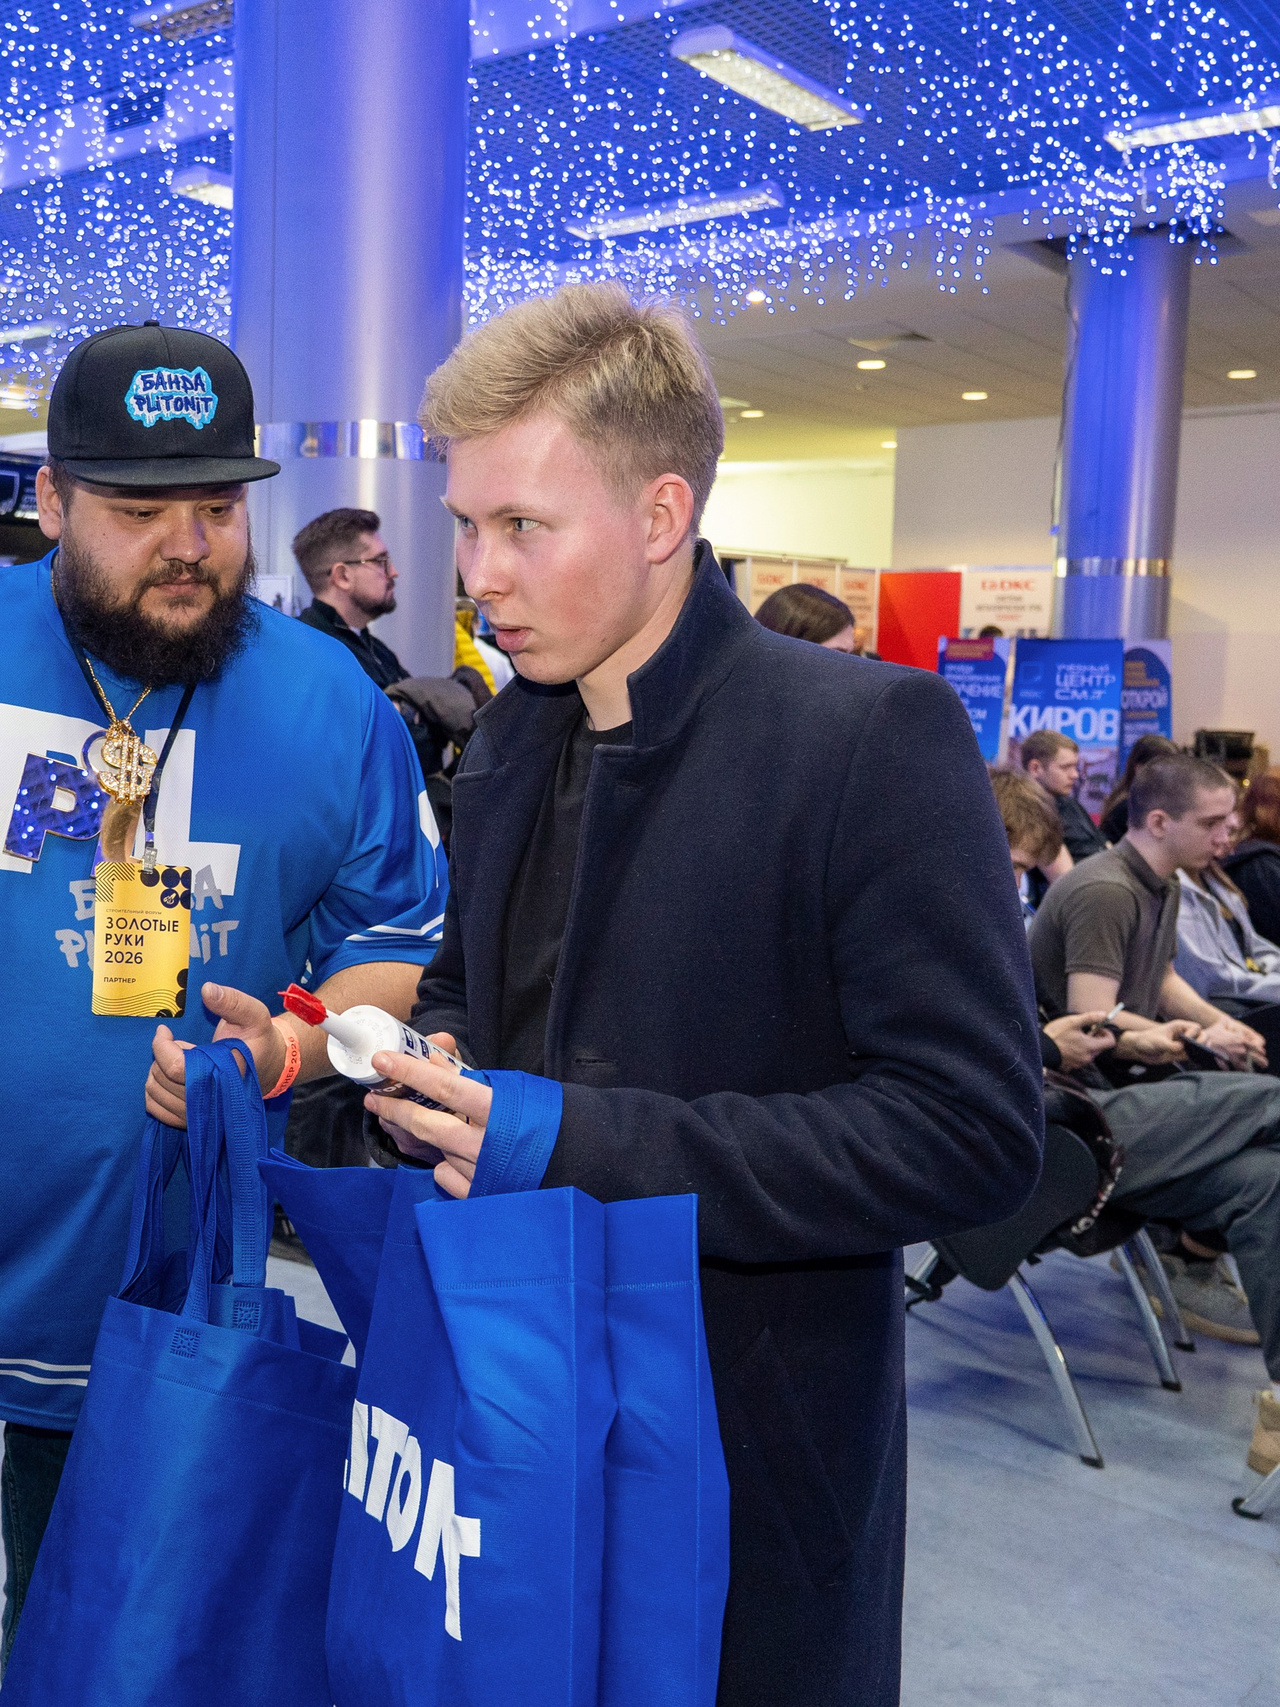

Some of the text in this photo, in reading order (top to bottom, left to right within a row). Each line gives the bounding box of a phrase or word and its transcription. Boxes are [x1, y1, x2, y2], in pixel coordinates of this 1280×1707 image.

[141, 371, 206, 393] БАНДА
[1009, 703, 1120, 741] КИРОВ
[106, 916, 179, 932] ЗОЛОТЫЕ
[105, 933, 144, 946] РУКИ
[104, 950, 143, 964] 2026
